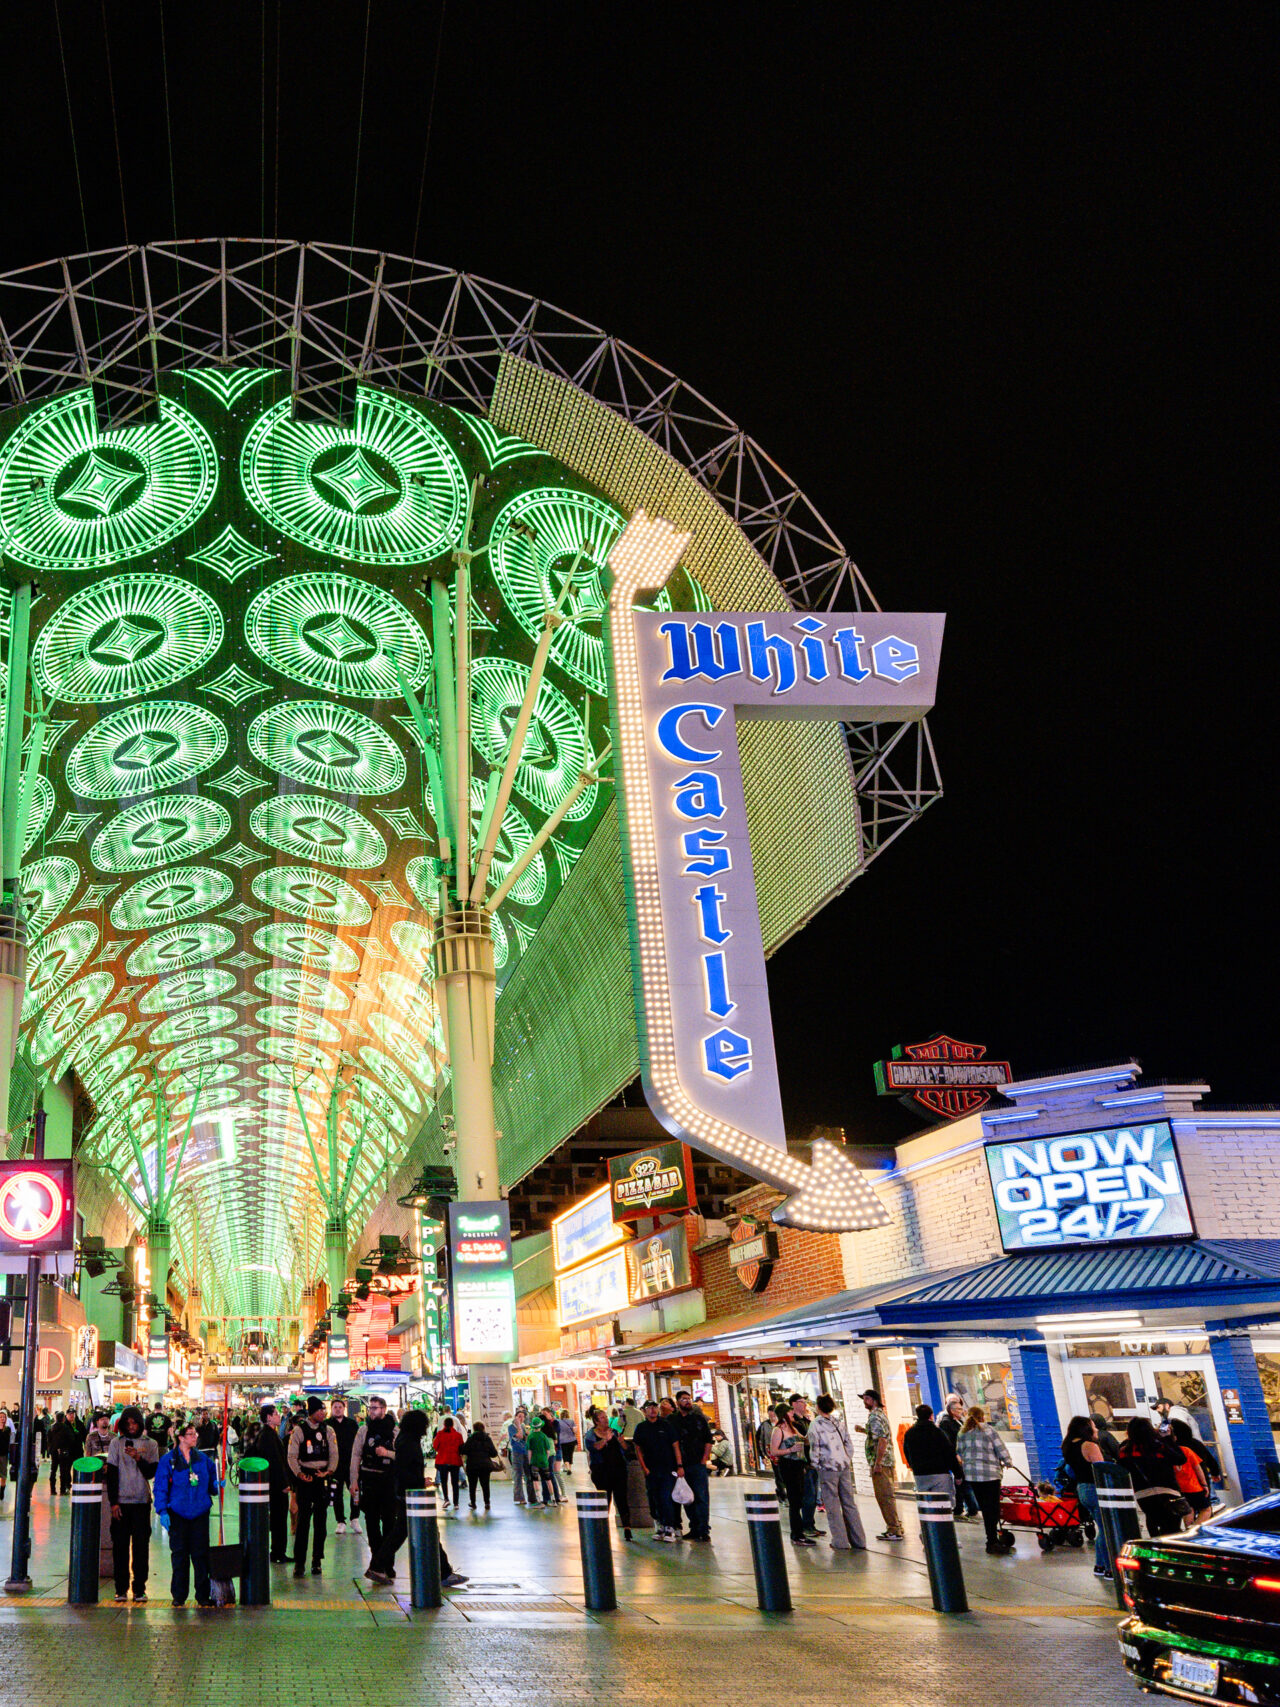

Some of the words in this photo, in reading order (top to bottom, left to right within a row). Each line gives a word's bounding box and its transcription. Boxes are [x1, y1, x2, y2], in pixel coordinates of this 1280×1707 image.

[658, 616, 921, 695] White
[657, 702, 754, 1085] Castle
[892, 1065, 1007, 1085] HARLEY-DAVIDSON
[635, 1162, 655, 1178] 922
[1000, 1126, 1158, 1179] NOW
[617, 1178, 652, 1198] PIZZA
[652, 1172, 679, 1190] BAR
[997, 1160, 1182, 1213] OPEN
[1020, 1198, 1166, 1245] 24/7
[511, 1375, 533, 1385] ACOS
[1151, 1565, 1235, 1585] VOLVO
